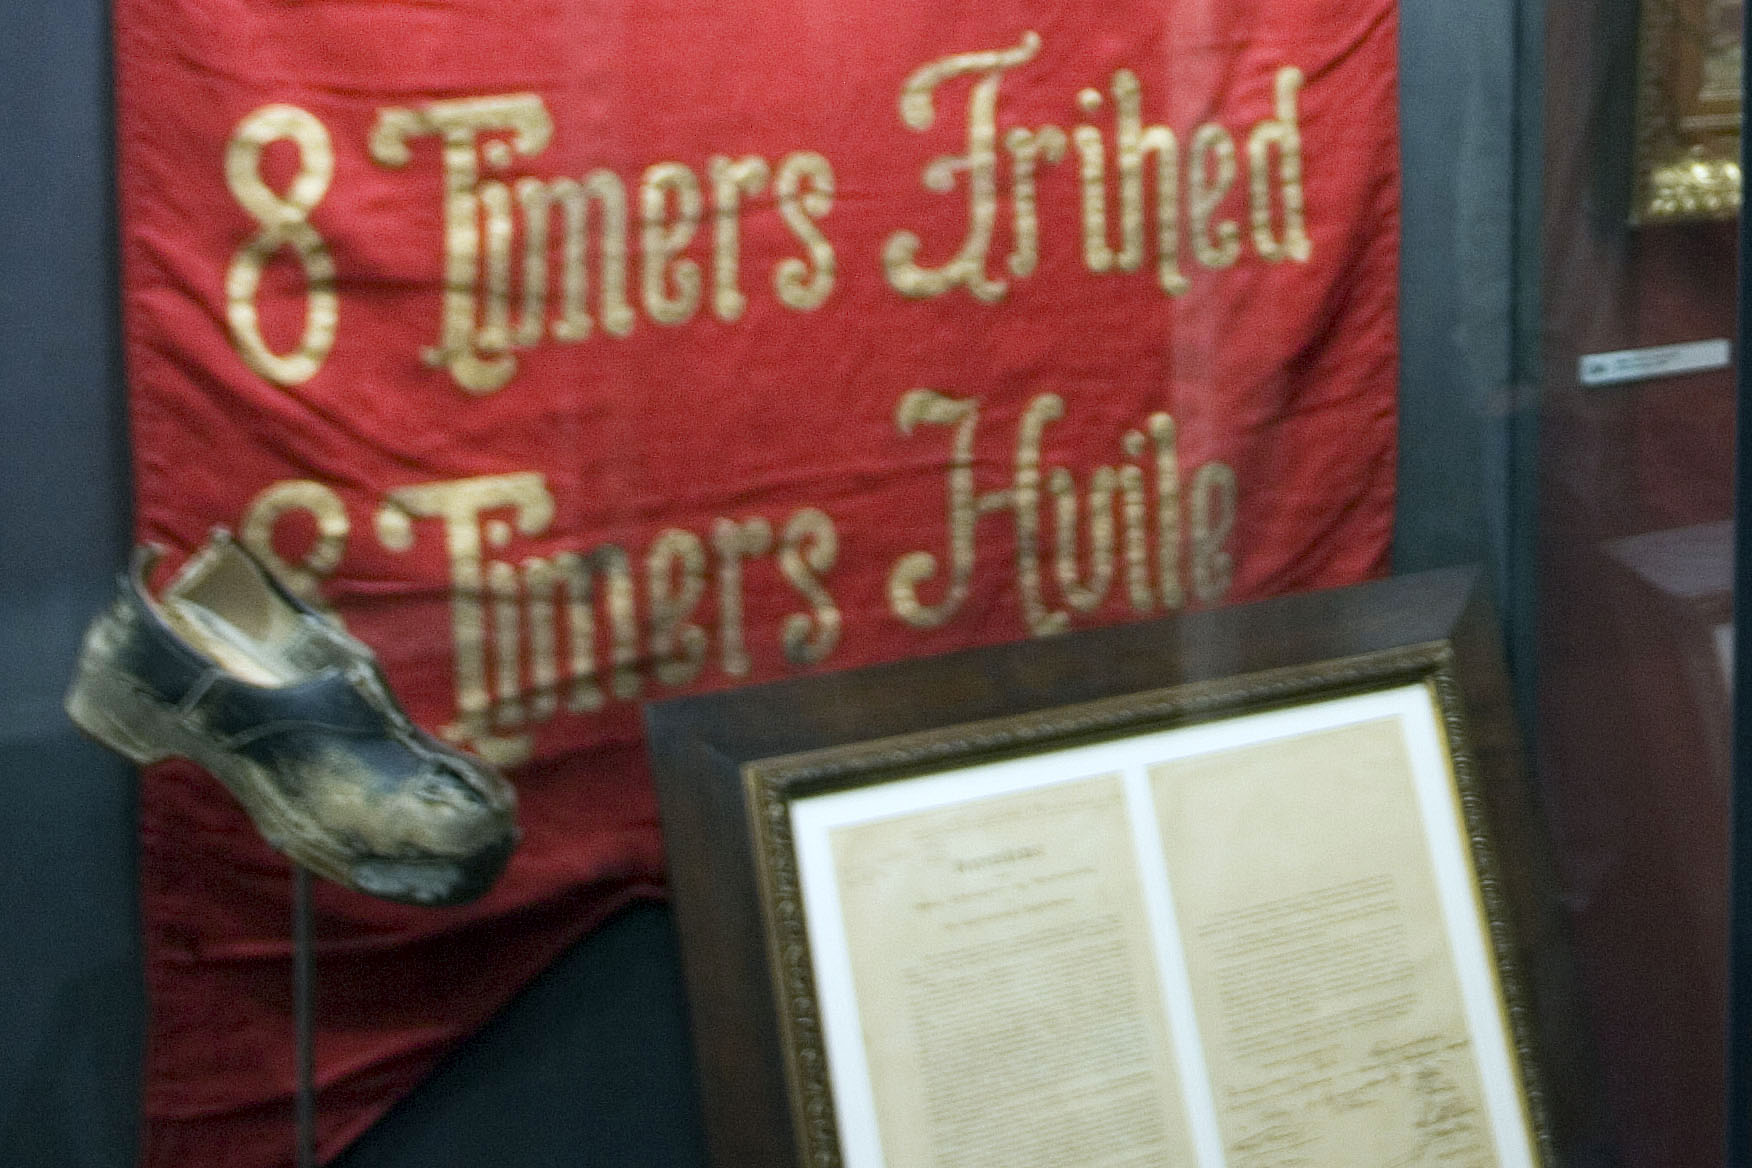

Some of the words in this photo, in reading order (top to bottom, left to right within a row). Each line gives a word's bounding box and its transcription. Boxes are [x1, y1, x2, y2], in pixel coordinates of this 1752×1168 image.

[225, 105, 338, 387] 8
[369, 94, 837, 395] Timers
[883, 31, 1311, 303] Frihed
[374, 472, 841, 767] Timers
